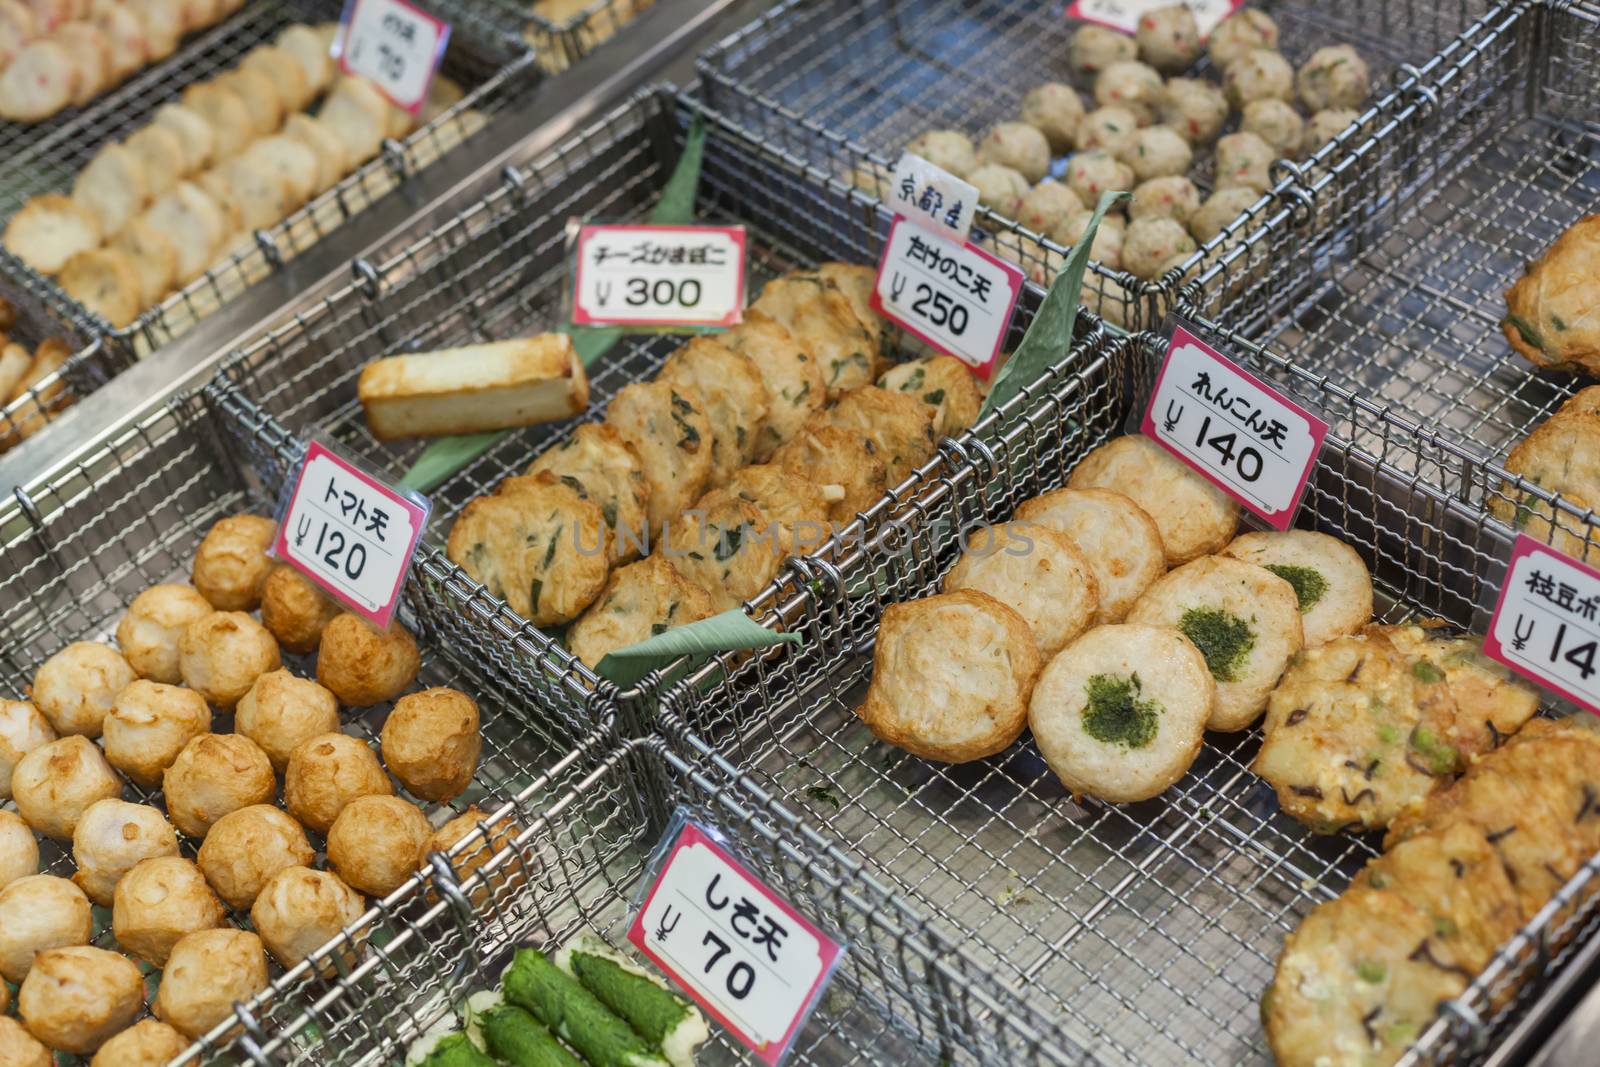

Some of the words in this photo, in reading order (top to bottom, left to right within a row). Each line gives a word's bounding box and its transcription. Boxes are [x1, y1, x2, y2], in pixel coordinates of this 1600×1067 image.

[625, 278, 701, 307] 300
[906, 236, 993, 304] たけのこ天
[911, 283, 969, 336] 250
[1191, 372, 1289, 450] れんこん天
[1195, 416, 1264, 482] 140
[325, 477, 389, 542] トマト天
[315, 522, 367, 581] 120
[1525, 570, 1600, 627] 枝豆ポ
[706, 873, 789, 962] しそ天
[702, 930, 756, 1000] 70
